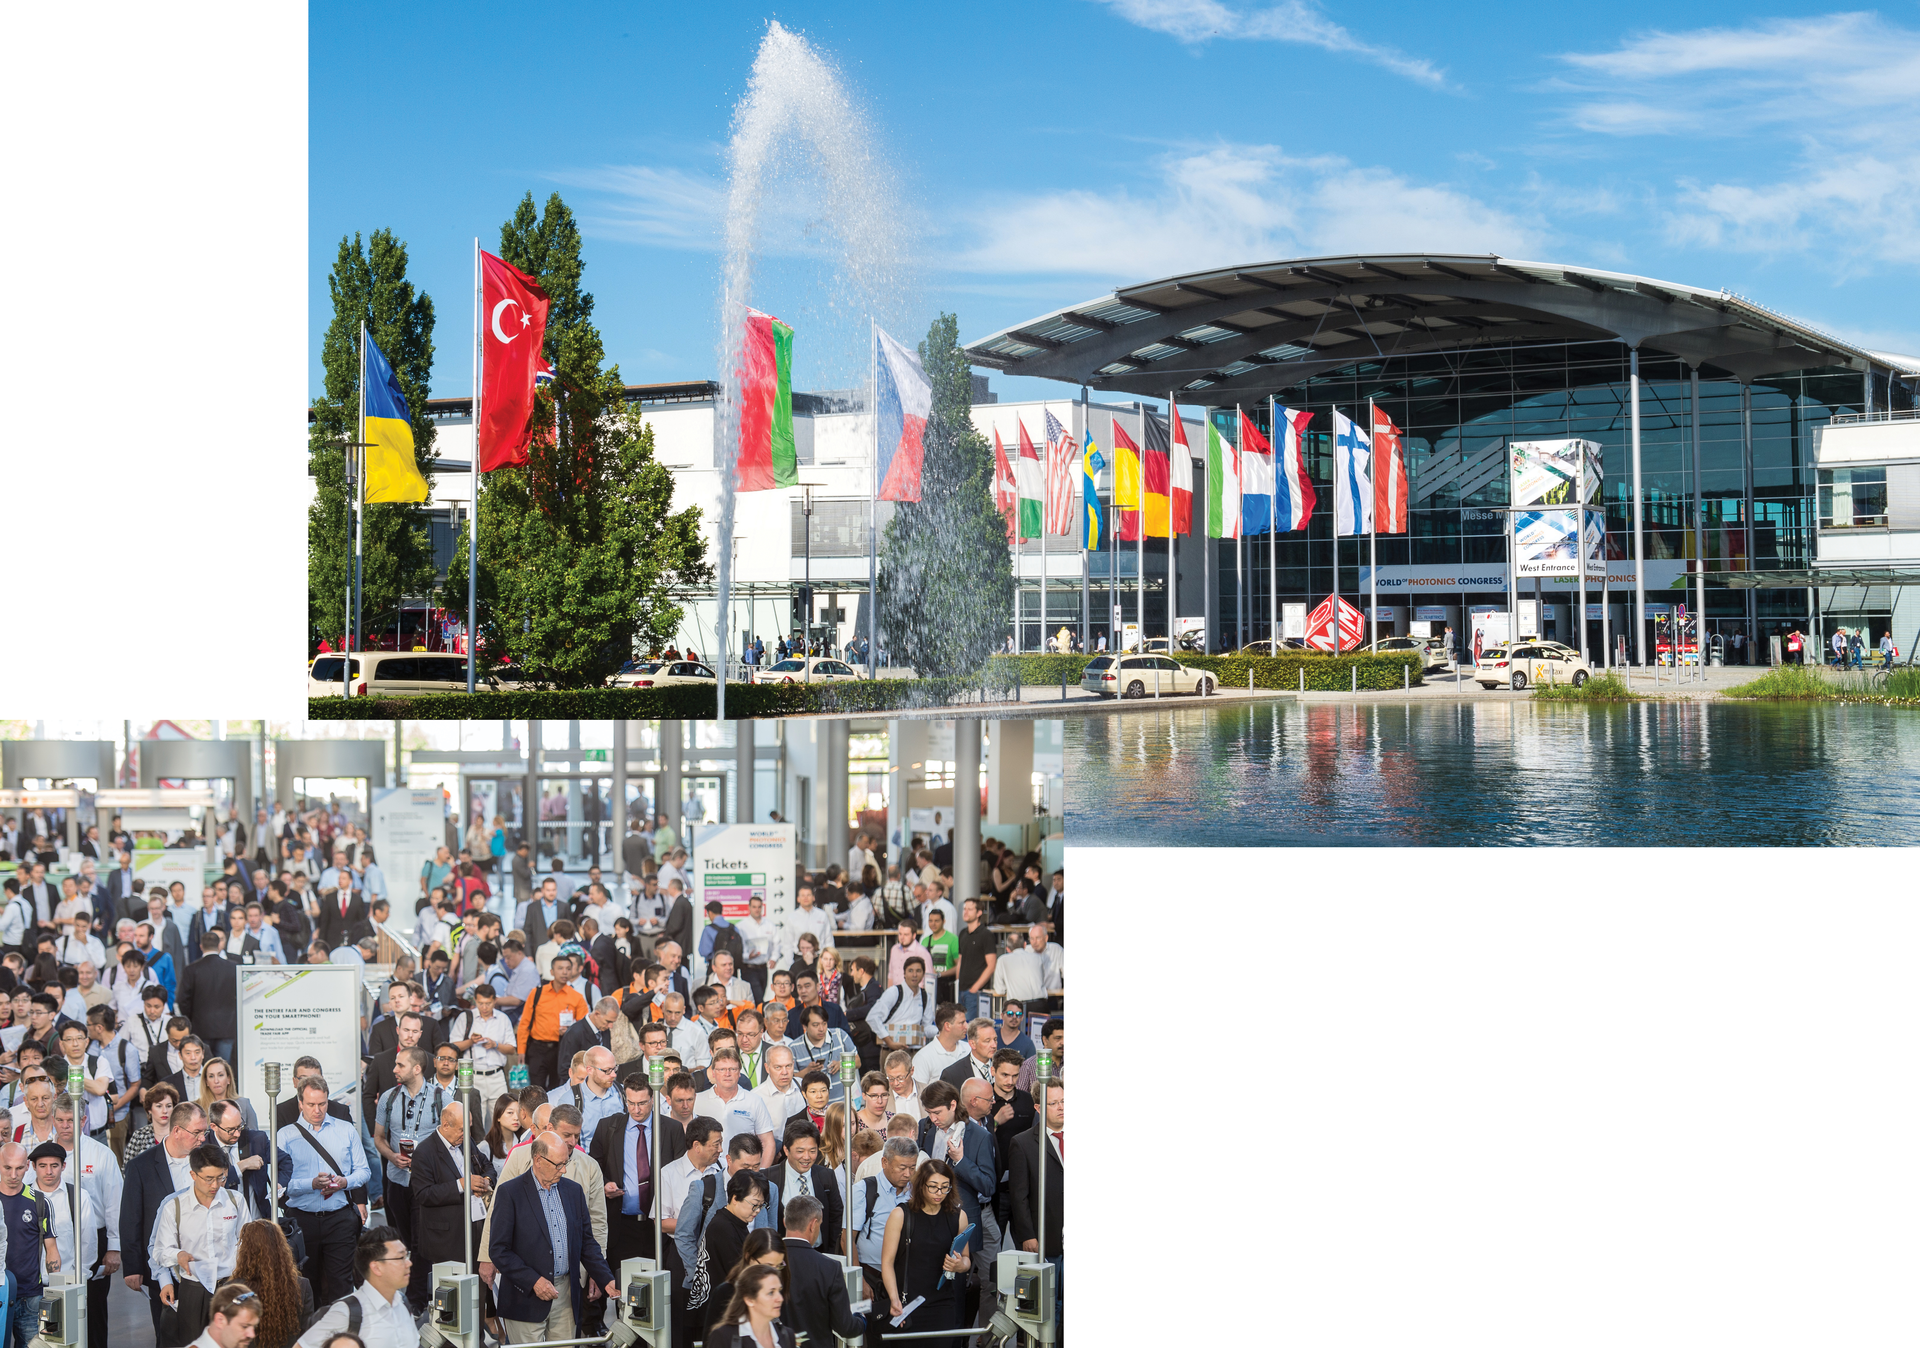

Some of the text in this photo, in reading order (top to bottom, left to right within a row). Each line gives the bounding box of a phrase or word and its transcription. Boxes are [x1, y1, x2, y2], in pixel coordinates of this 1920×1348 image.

[1461, 510, 1494, 520] Messe
[1519, 531, 1535, 543] WORLD
[1519, 563, 1576, 572] West Entrance
[1408, 577, 1456, 586] PHOTONICS
[1457, 576, 1503, 585] CONGRESS
[1584, 575, 1637, 583] PHOONICS
[704, 858, 748, 870] Tickets
